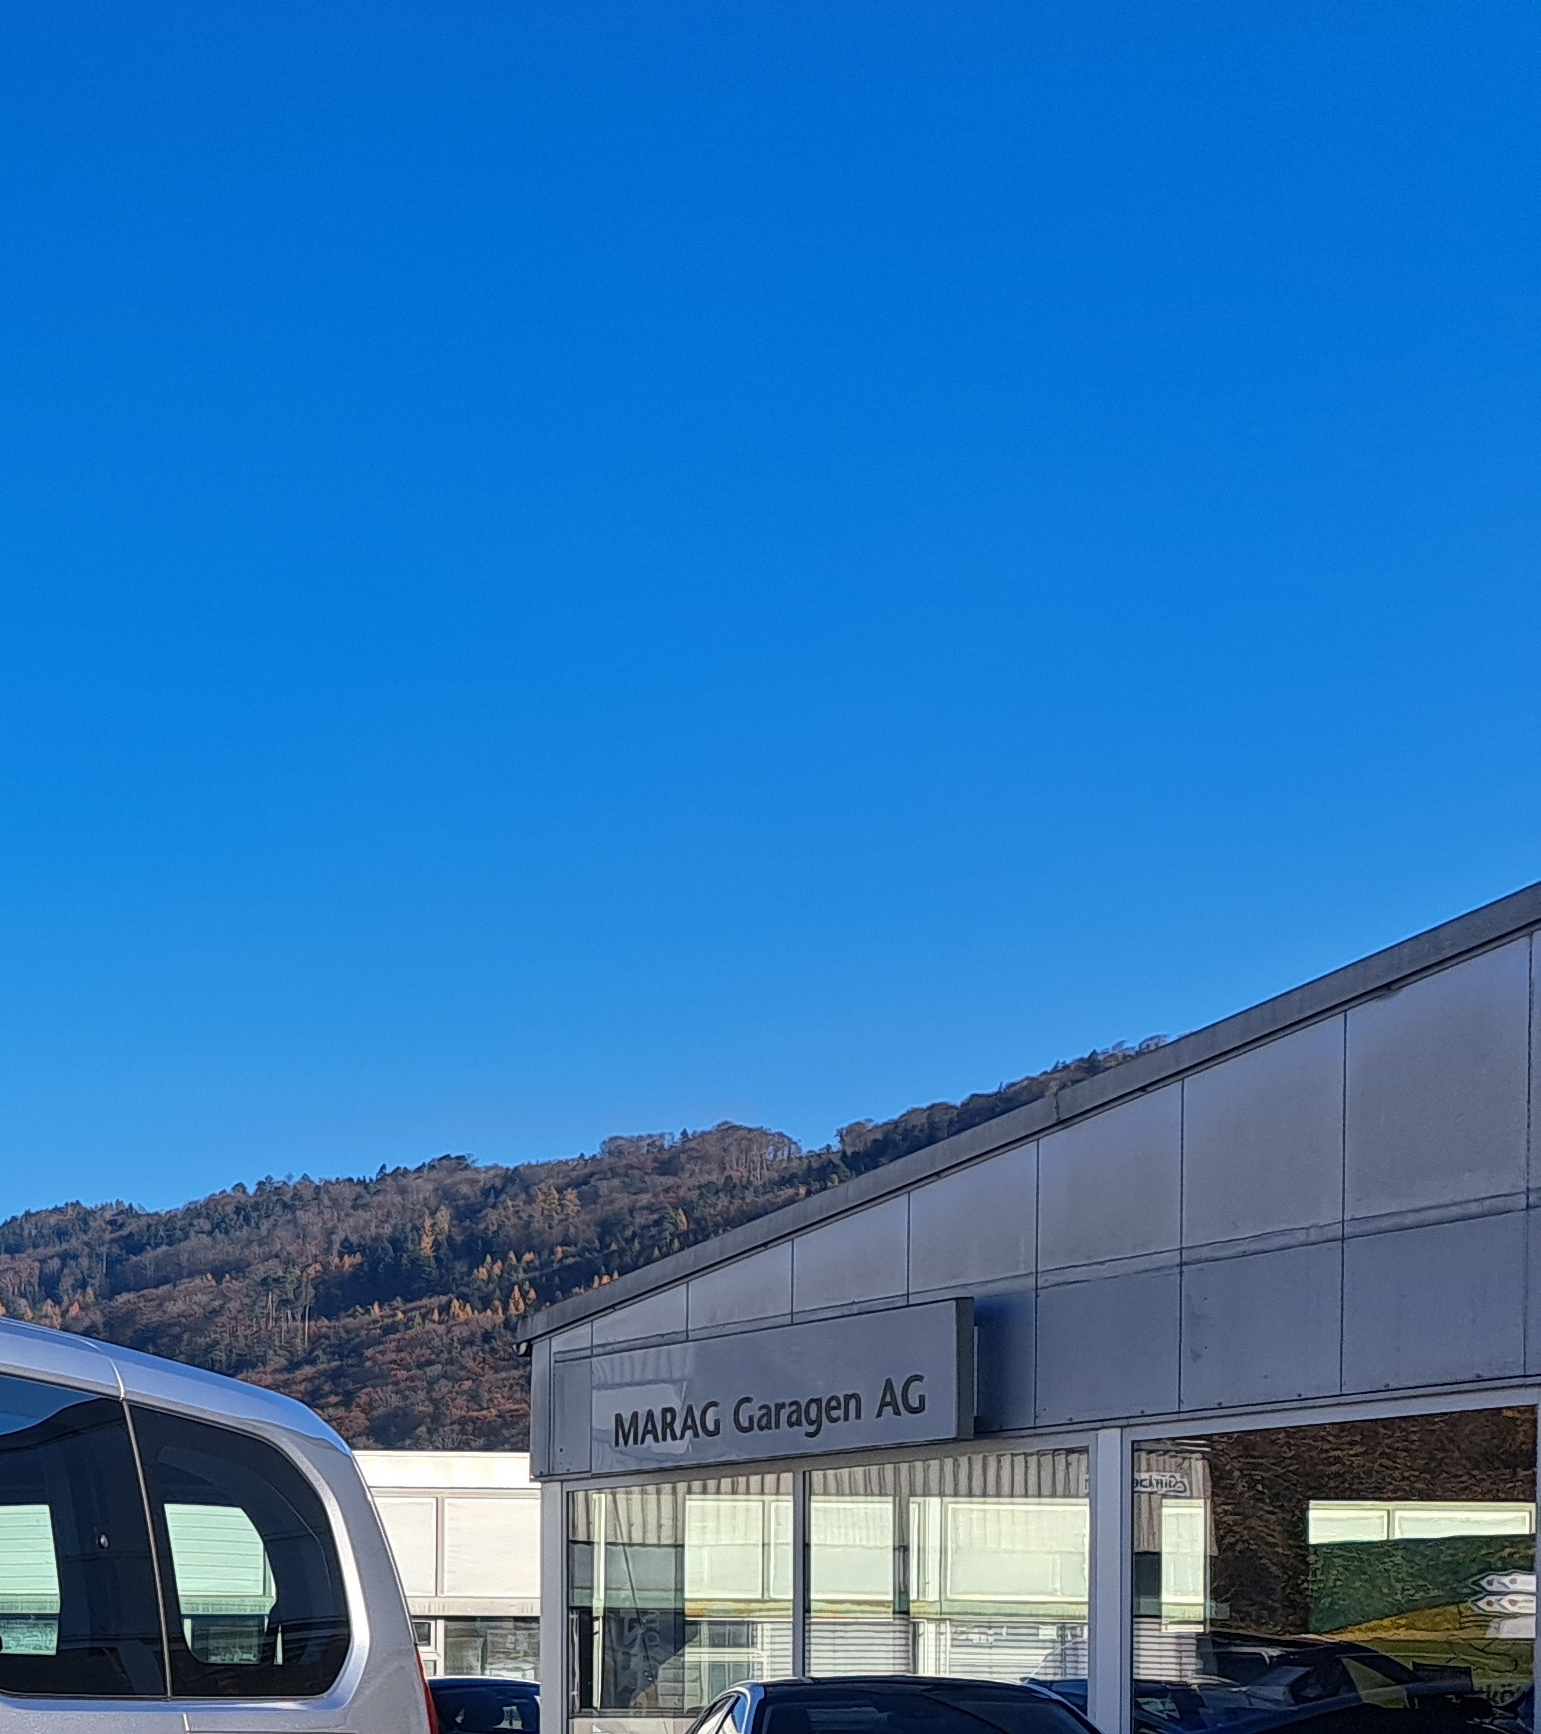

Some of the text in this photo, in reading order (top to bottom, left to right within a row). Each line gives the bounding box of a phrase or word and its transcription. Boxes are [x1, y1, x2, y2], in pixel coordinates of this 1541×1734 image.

[614, 1374, 926, 1448] MARAG Garagen AG
